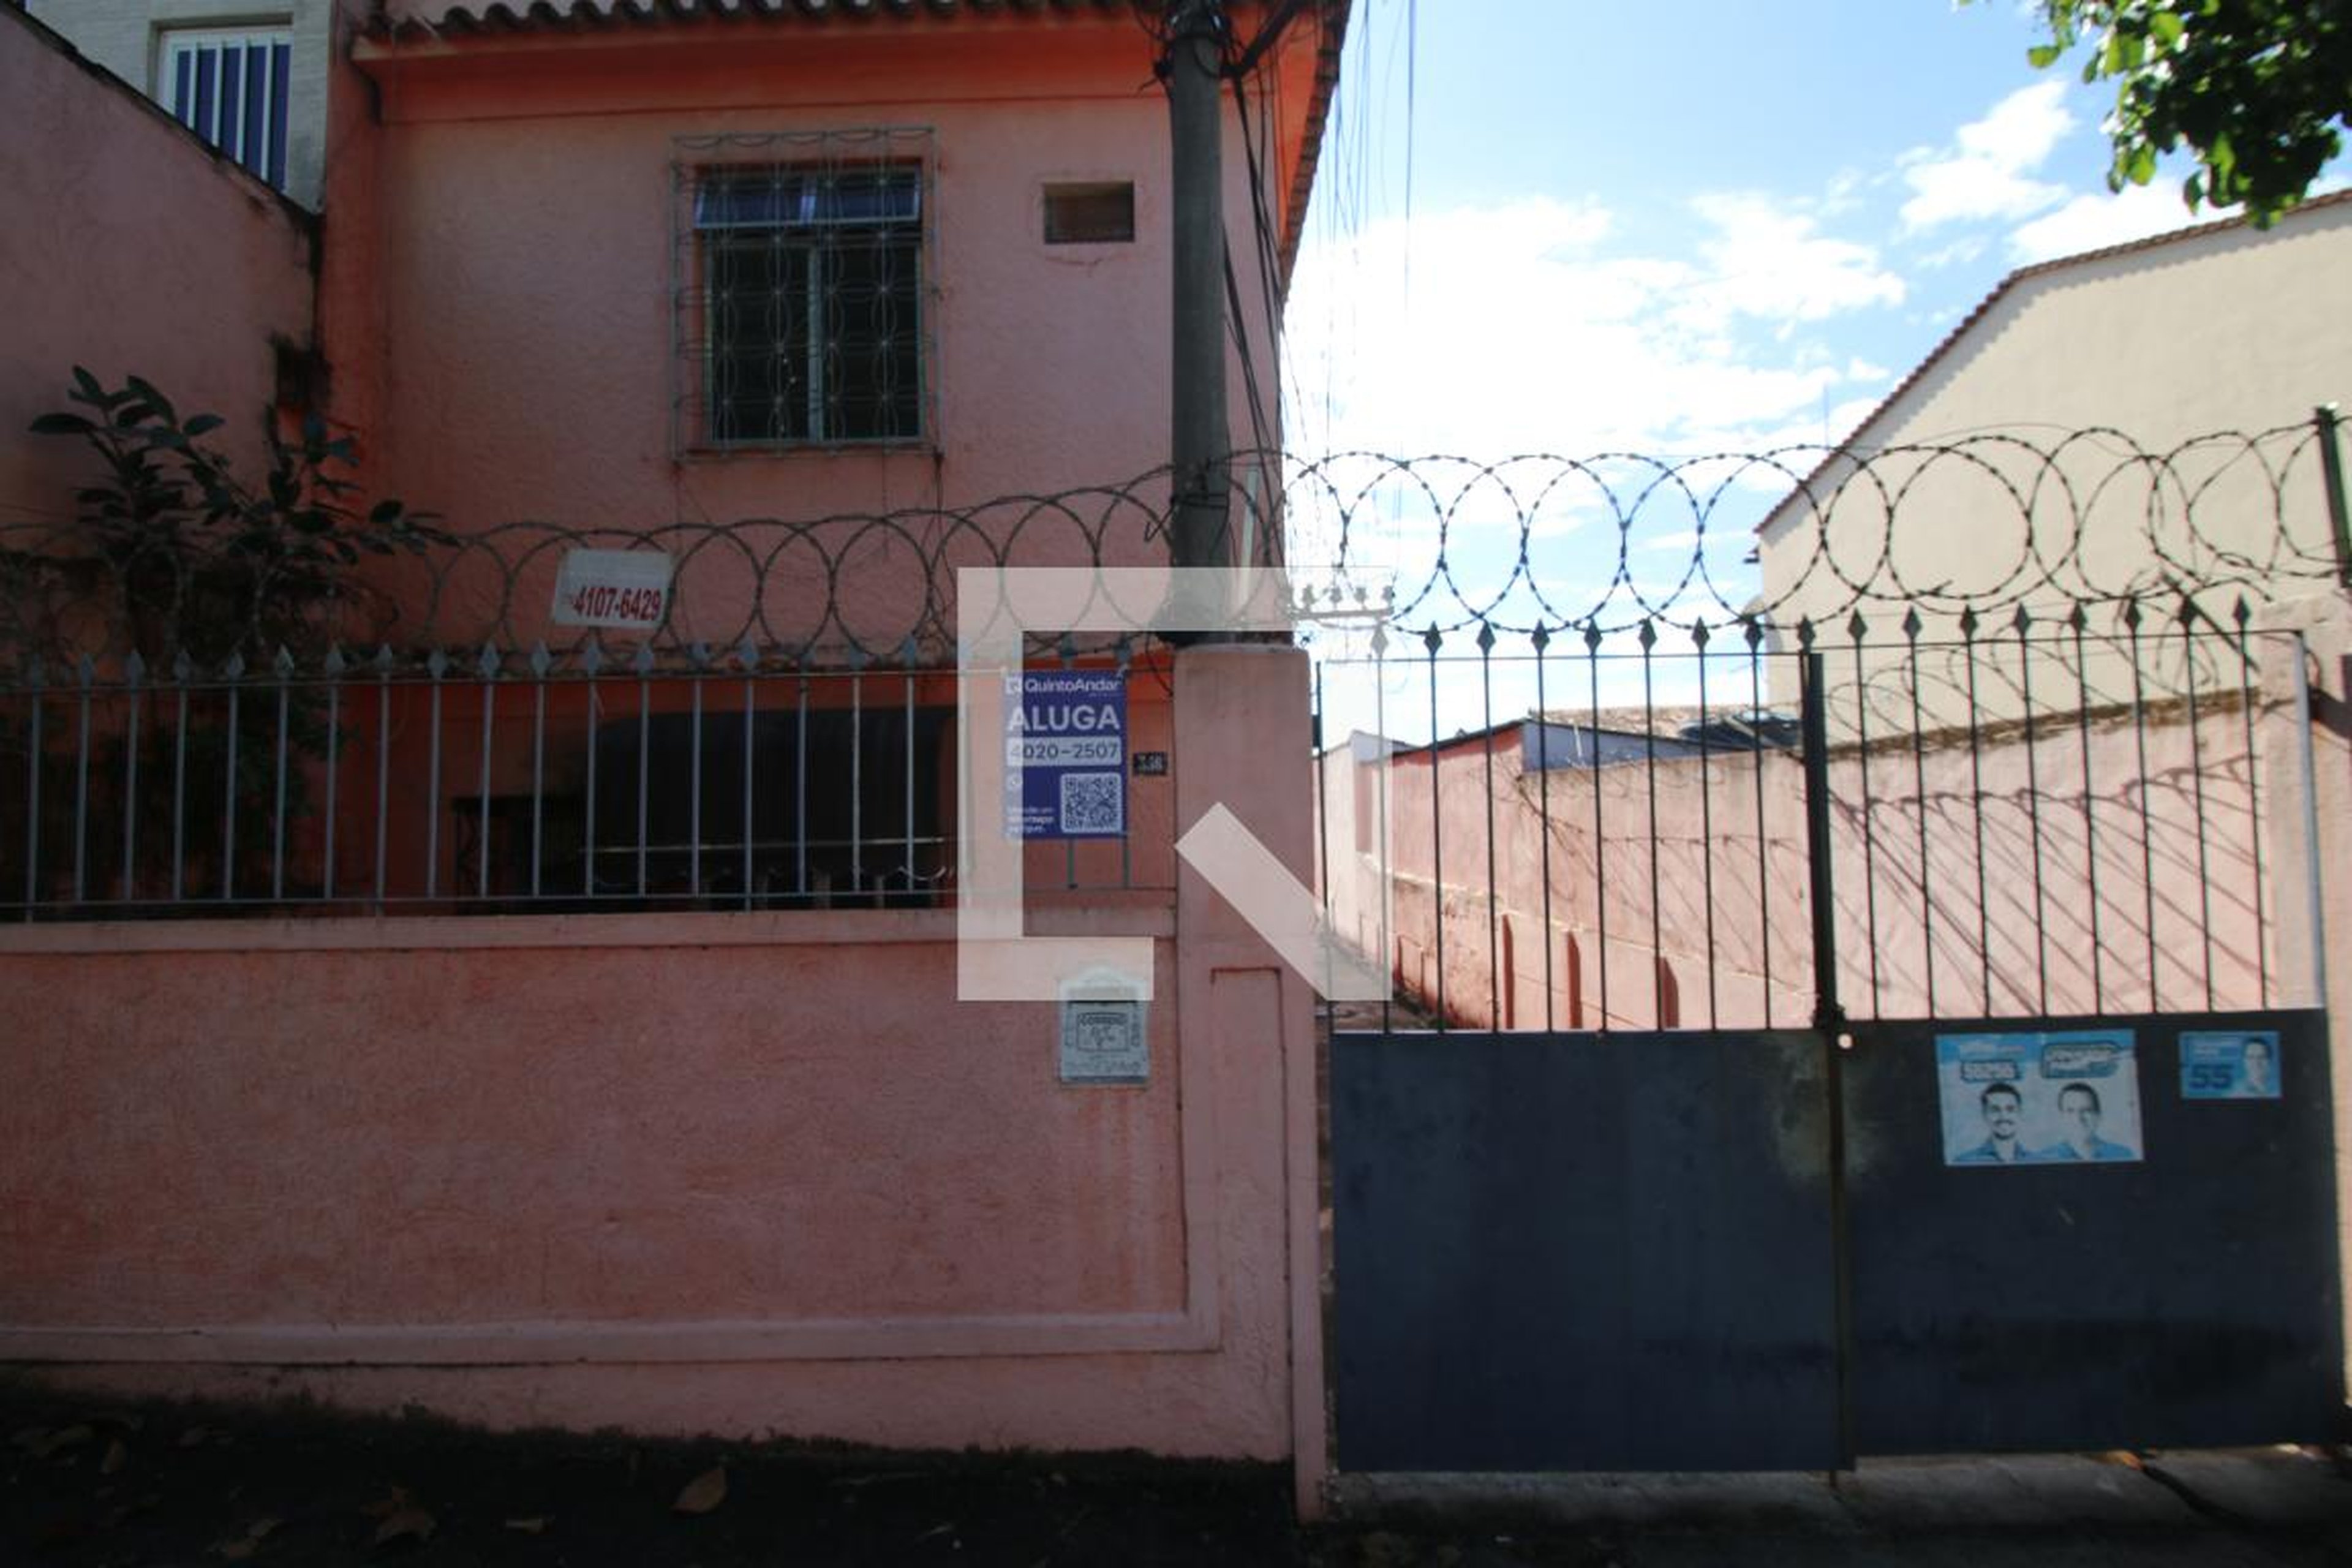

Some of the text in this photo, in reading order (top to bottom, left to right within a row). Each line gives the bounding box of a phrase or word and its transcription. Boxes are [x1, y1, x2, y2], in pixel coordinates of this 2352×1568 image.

[572, 586, 662, 620] 4107-6429
[1025, 678, 1120, 693] QuintoAndar
[1008, 706, 1120, 730] ALUGA
[2188, 1065, 2233, 1090] 55
